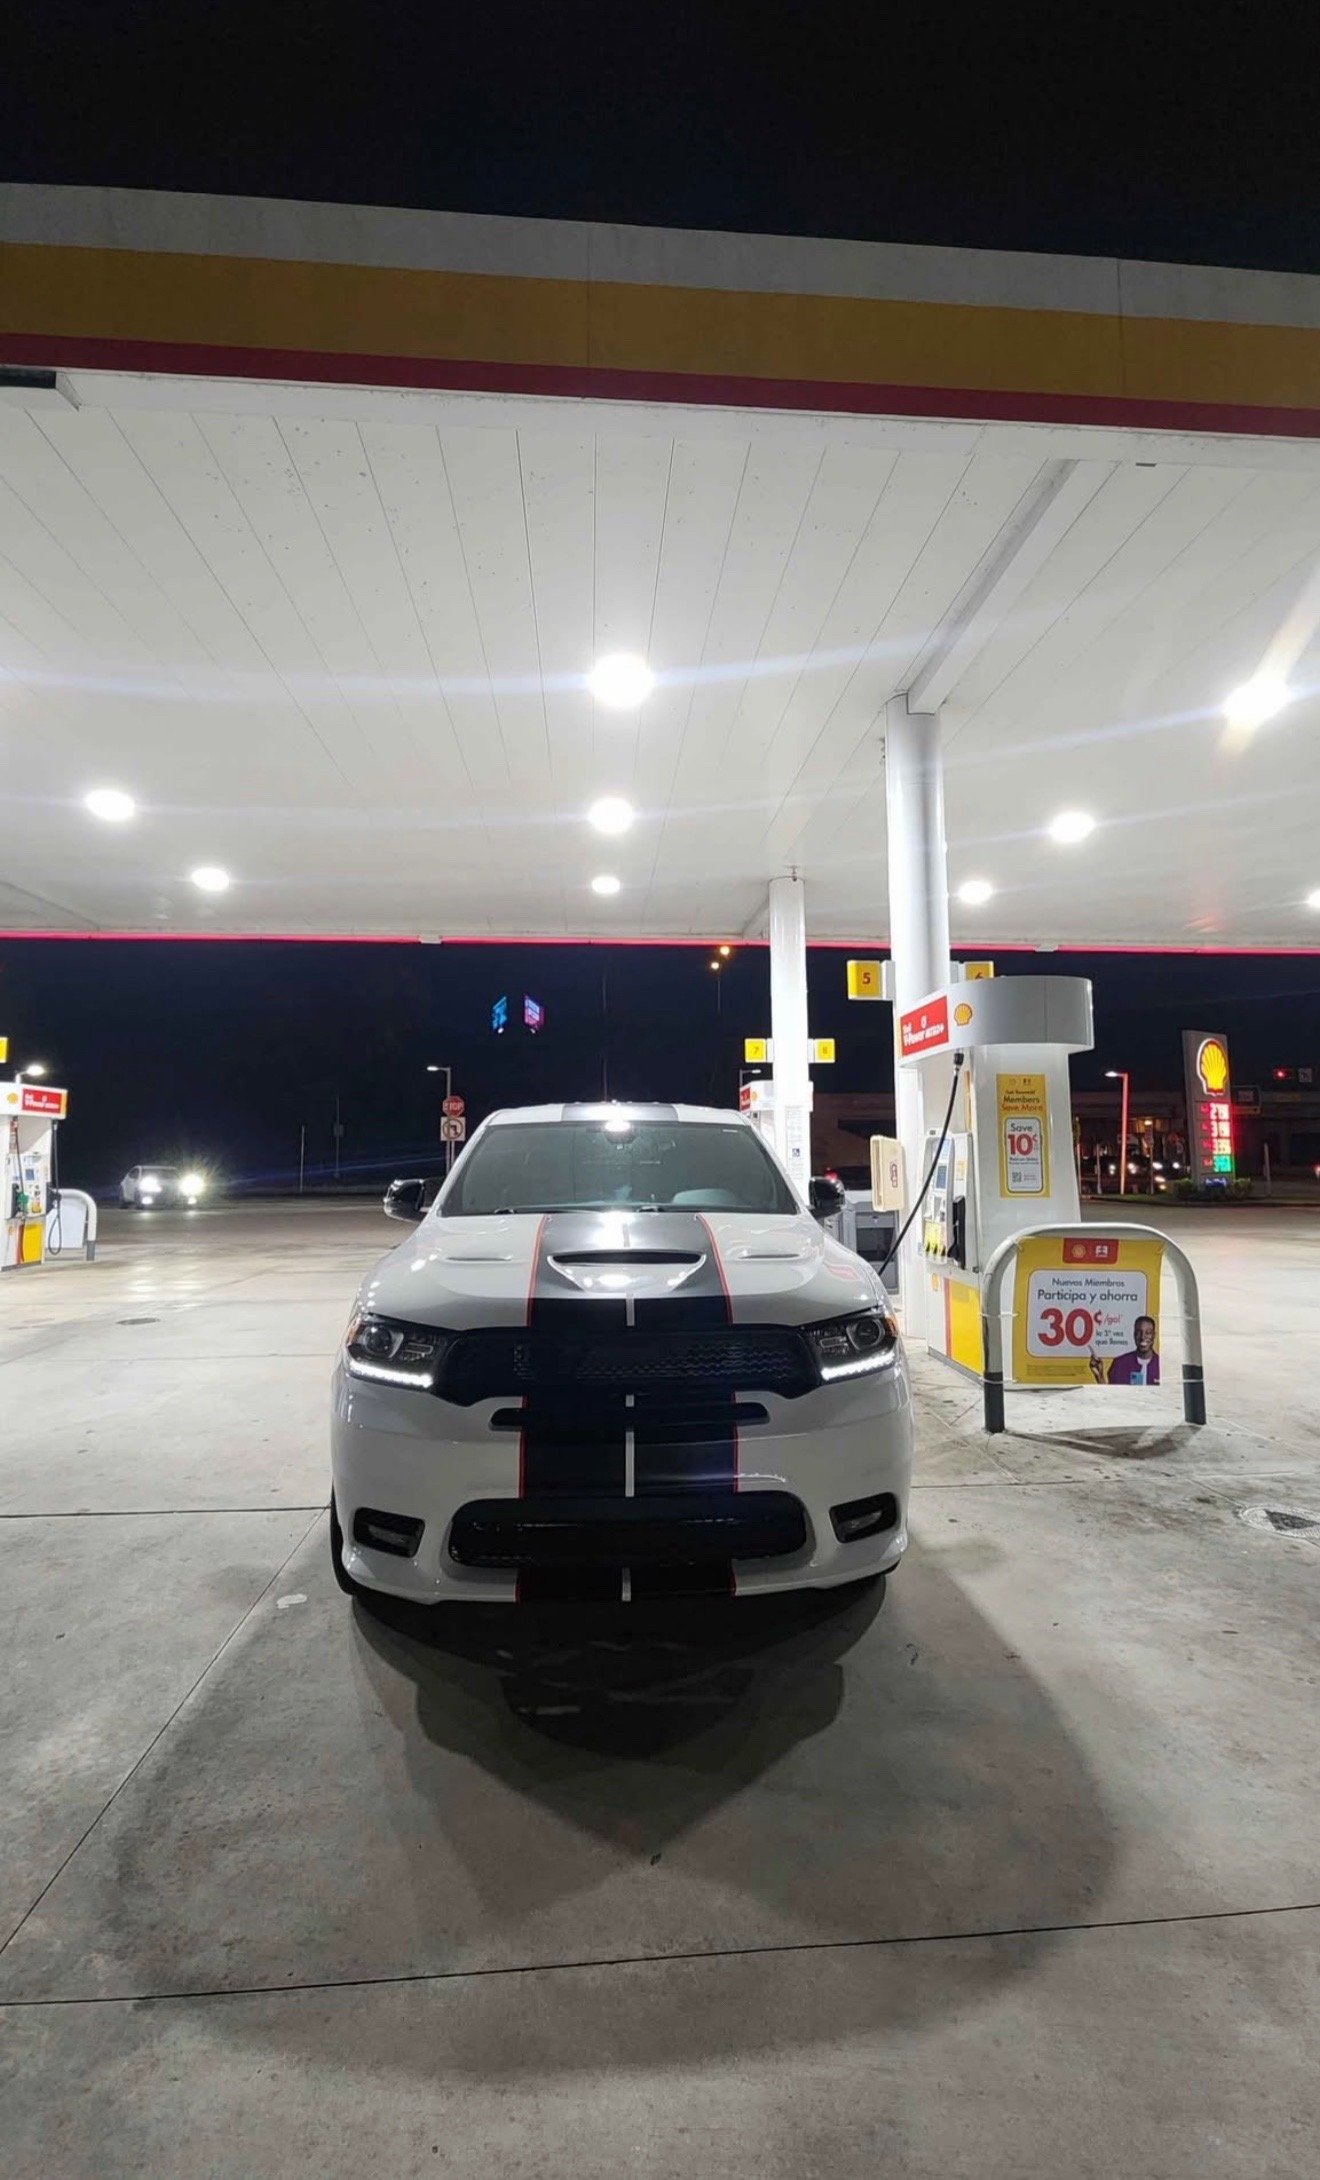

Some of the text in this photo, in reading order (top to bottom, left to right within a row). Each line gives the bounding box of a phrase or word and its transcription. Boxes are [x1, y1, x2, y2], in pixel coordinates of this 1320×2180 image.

[861, 972, 871, 984] 5
[1003, 1095, 1040, 1104] Members
[443, 1101, 464, 1111] STOP
[1001, 1103, 1043, 1112] Save More
[1010, 1123, 1033, 1132] Save
[1051, 1278, 1125, 1288] Nuevos Miembros
[1037, 1289, 1138, 1304] Participa y ahorra
